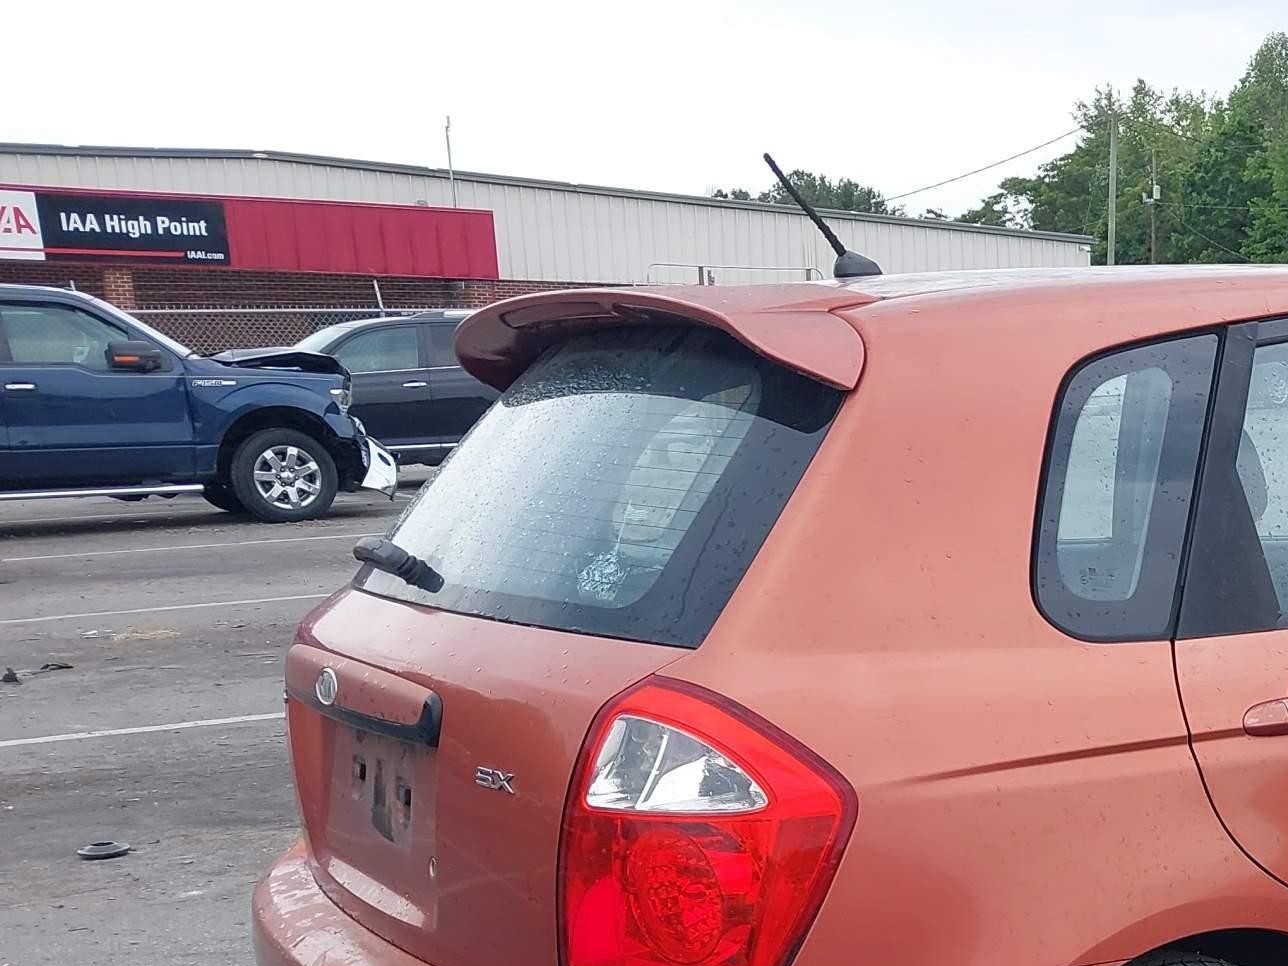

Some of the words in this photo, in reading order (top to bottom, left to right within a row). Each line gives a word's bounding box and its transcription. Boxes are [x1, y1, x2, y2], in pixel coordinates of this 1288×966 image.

[59, 212, 101, 233] IAA
[104, 214, 152, 238] High
[156, 216, 209, 237] Point
